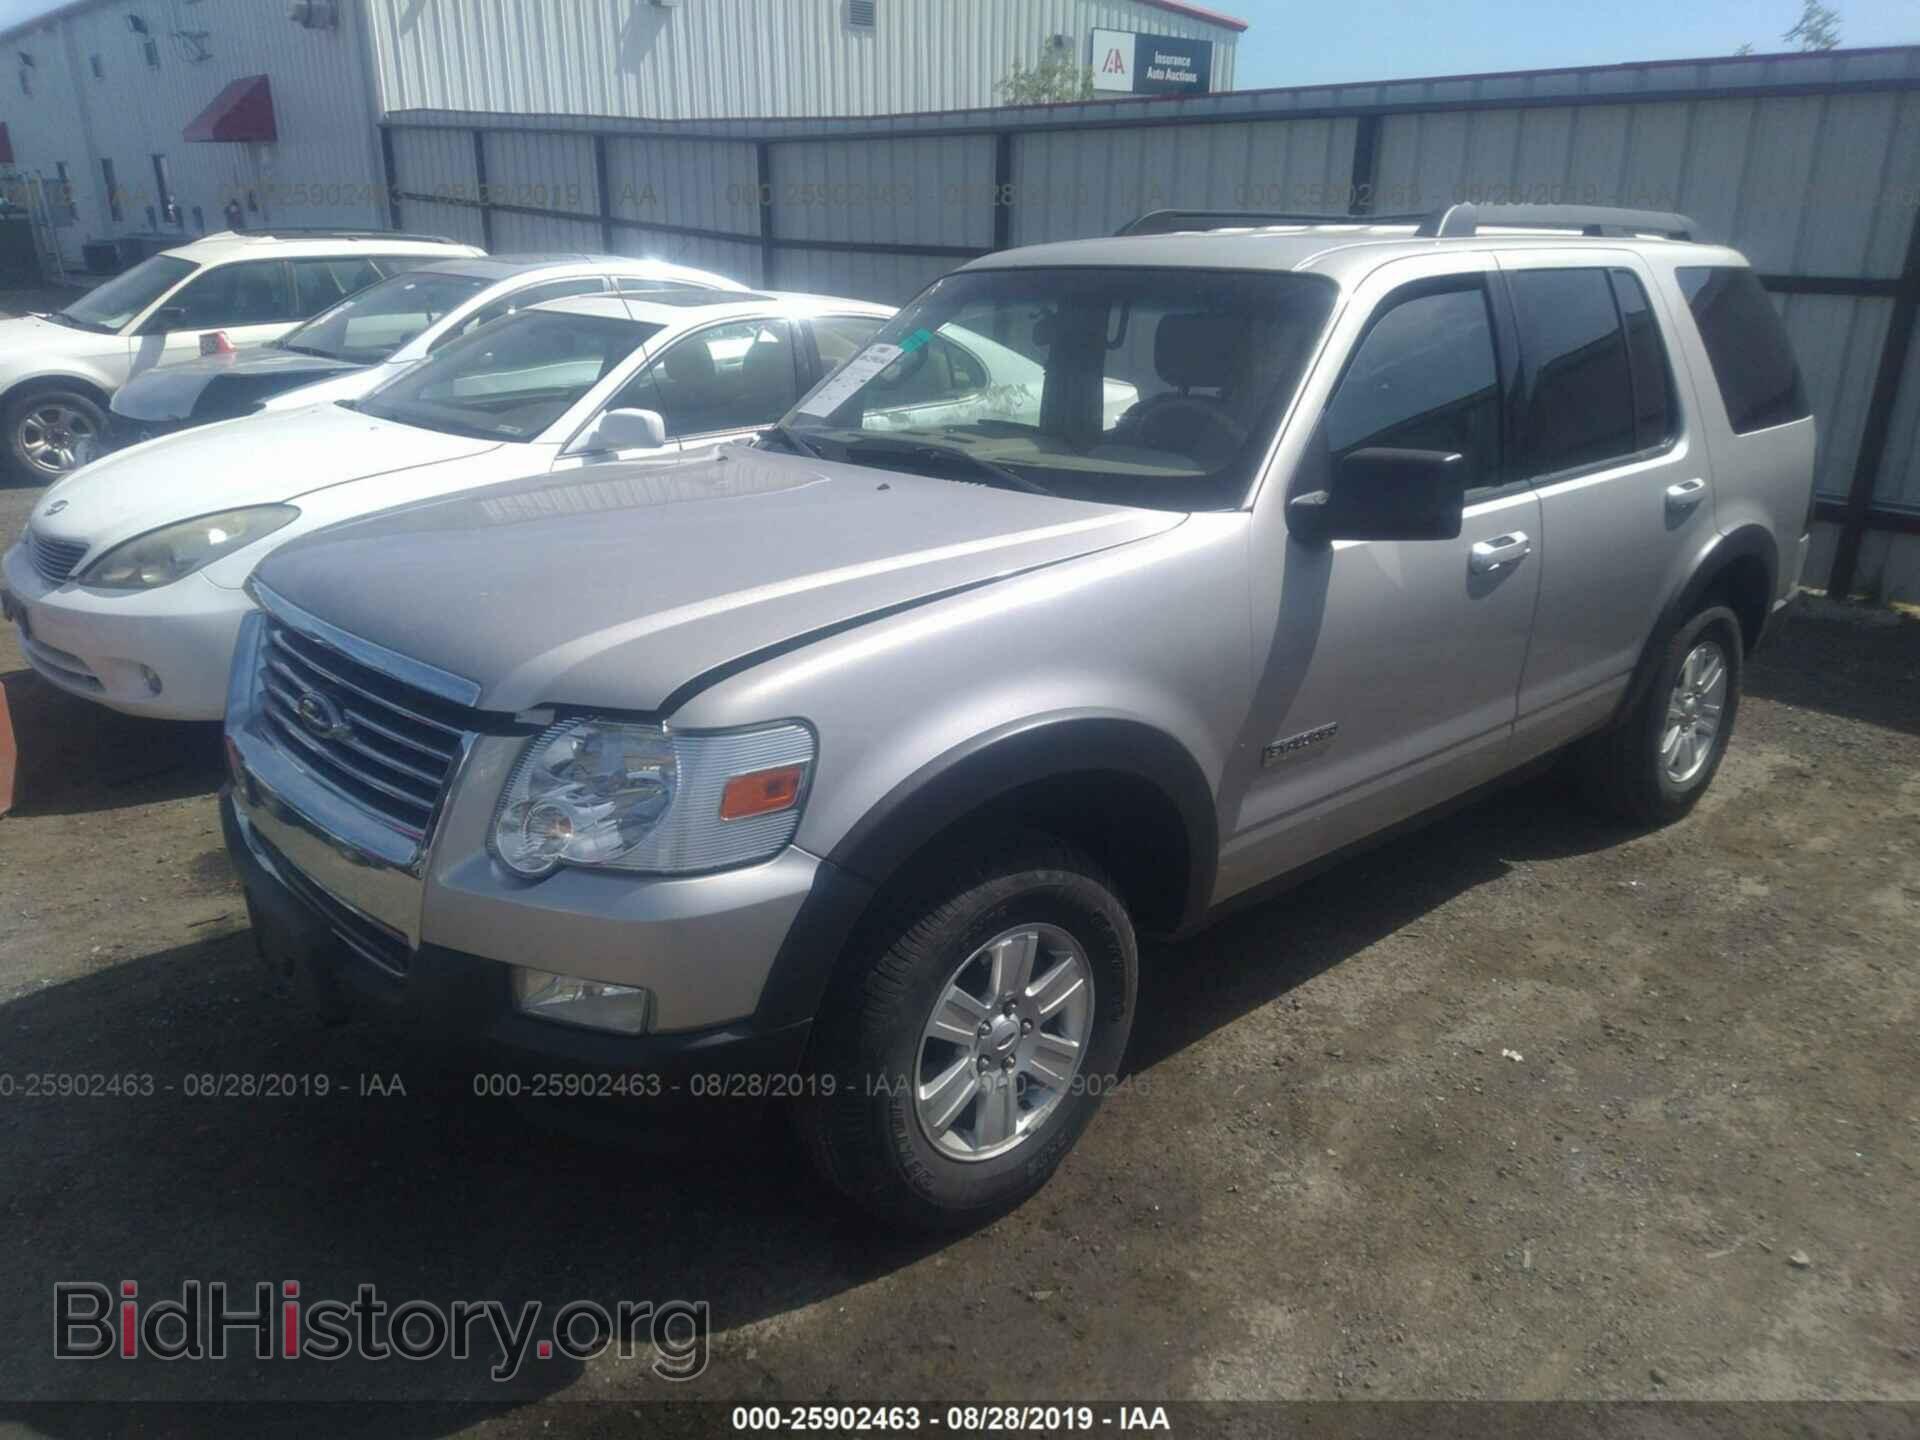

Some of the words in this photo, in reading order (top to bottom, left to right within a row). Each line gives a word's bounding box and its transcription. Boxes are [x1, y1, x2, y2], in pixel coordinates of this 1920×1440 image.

[1154, 50, 1191, 67] Insurance
[1146, 66, 1165, 81] Auto
[1166, 68, 1198, 83] Auctions
